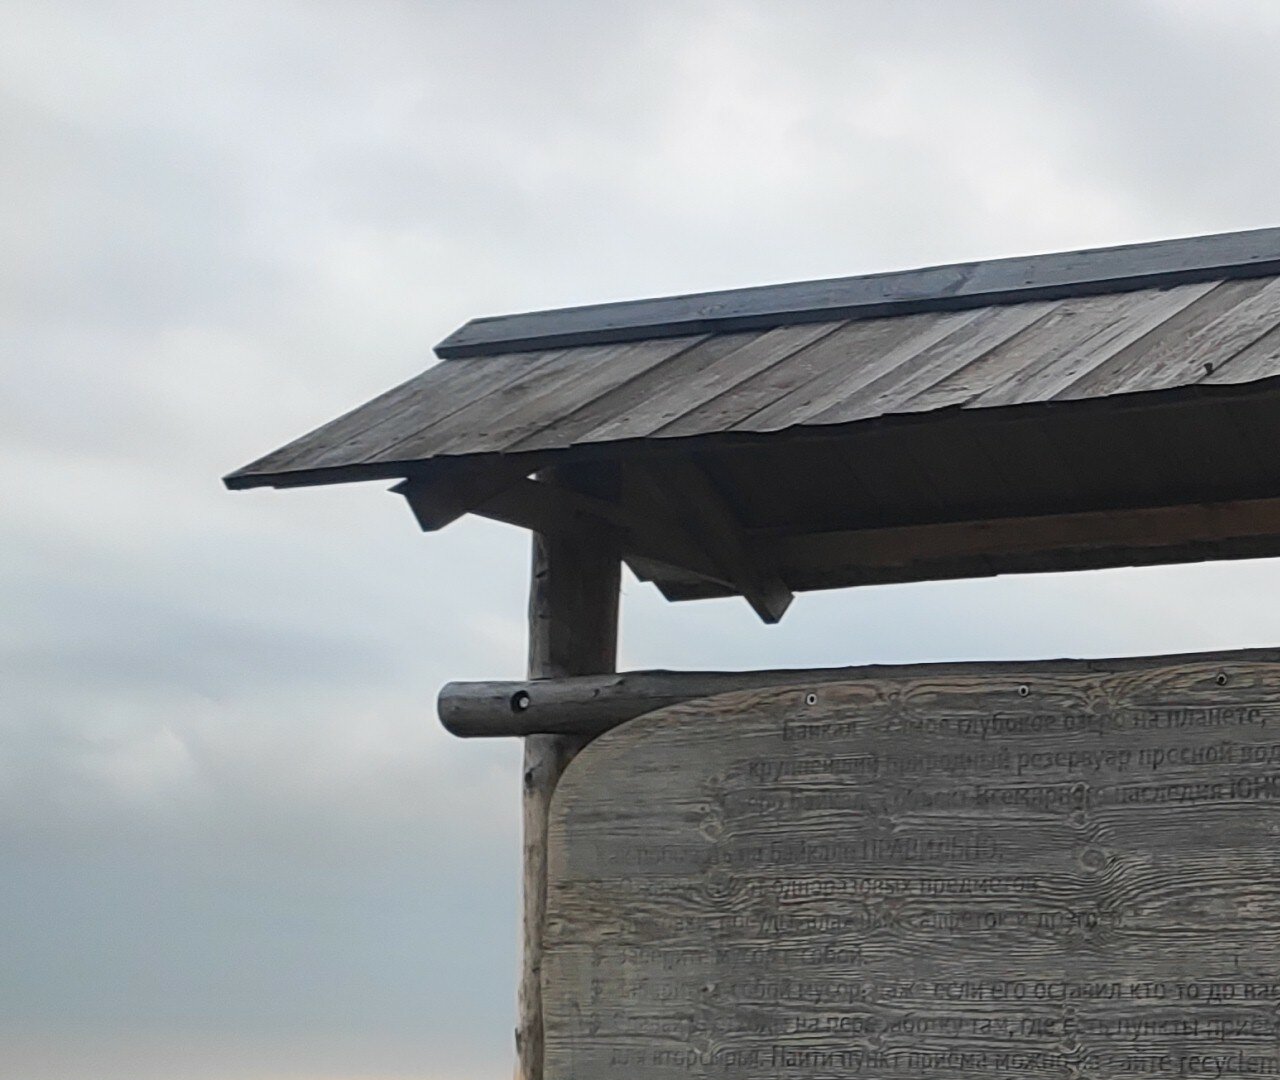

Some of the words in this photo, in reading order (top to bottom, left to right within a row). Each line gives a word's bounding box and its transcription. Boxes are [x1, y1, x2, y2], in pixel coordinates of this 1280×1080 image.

[956, 706, 1056, 741] глубокое
[1134, 710, 1161, 730] на
[1167, 704, 1267, 731] планете,
[1017, 749, 1131, 778] резервуар
[1140, 739, 1233, 772] пресной
[934, 977, 984, 999] если
[990, 978, 1028, 1000] его
[1034, 979, 1123, 1001] оставил
[840, 1048, 900, 1074] пункт
